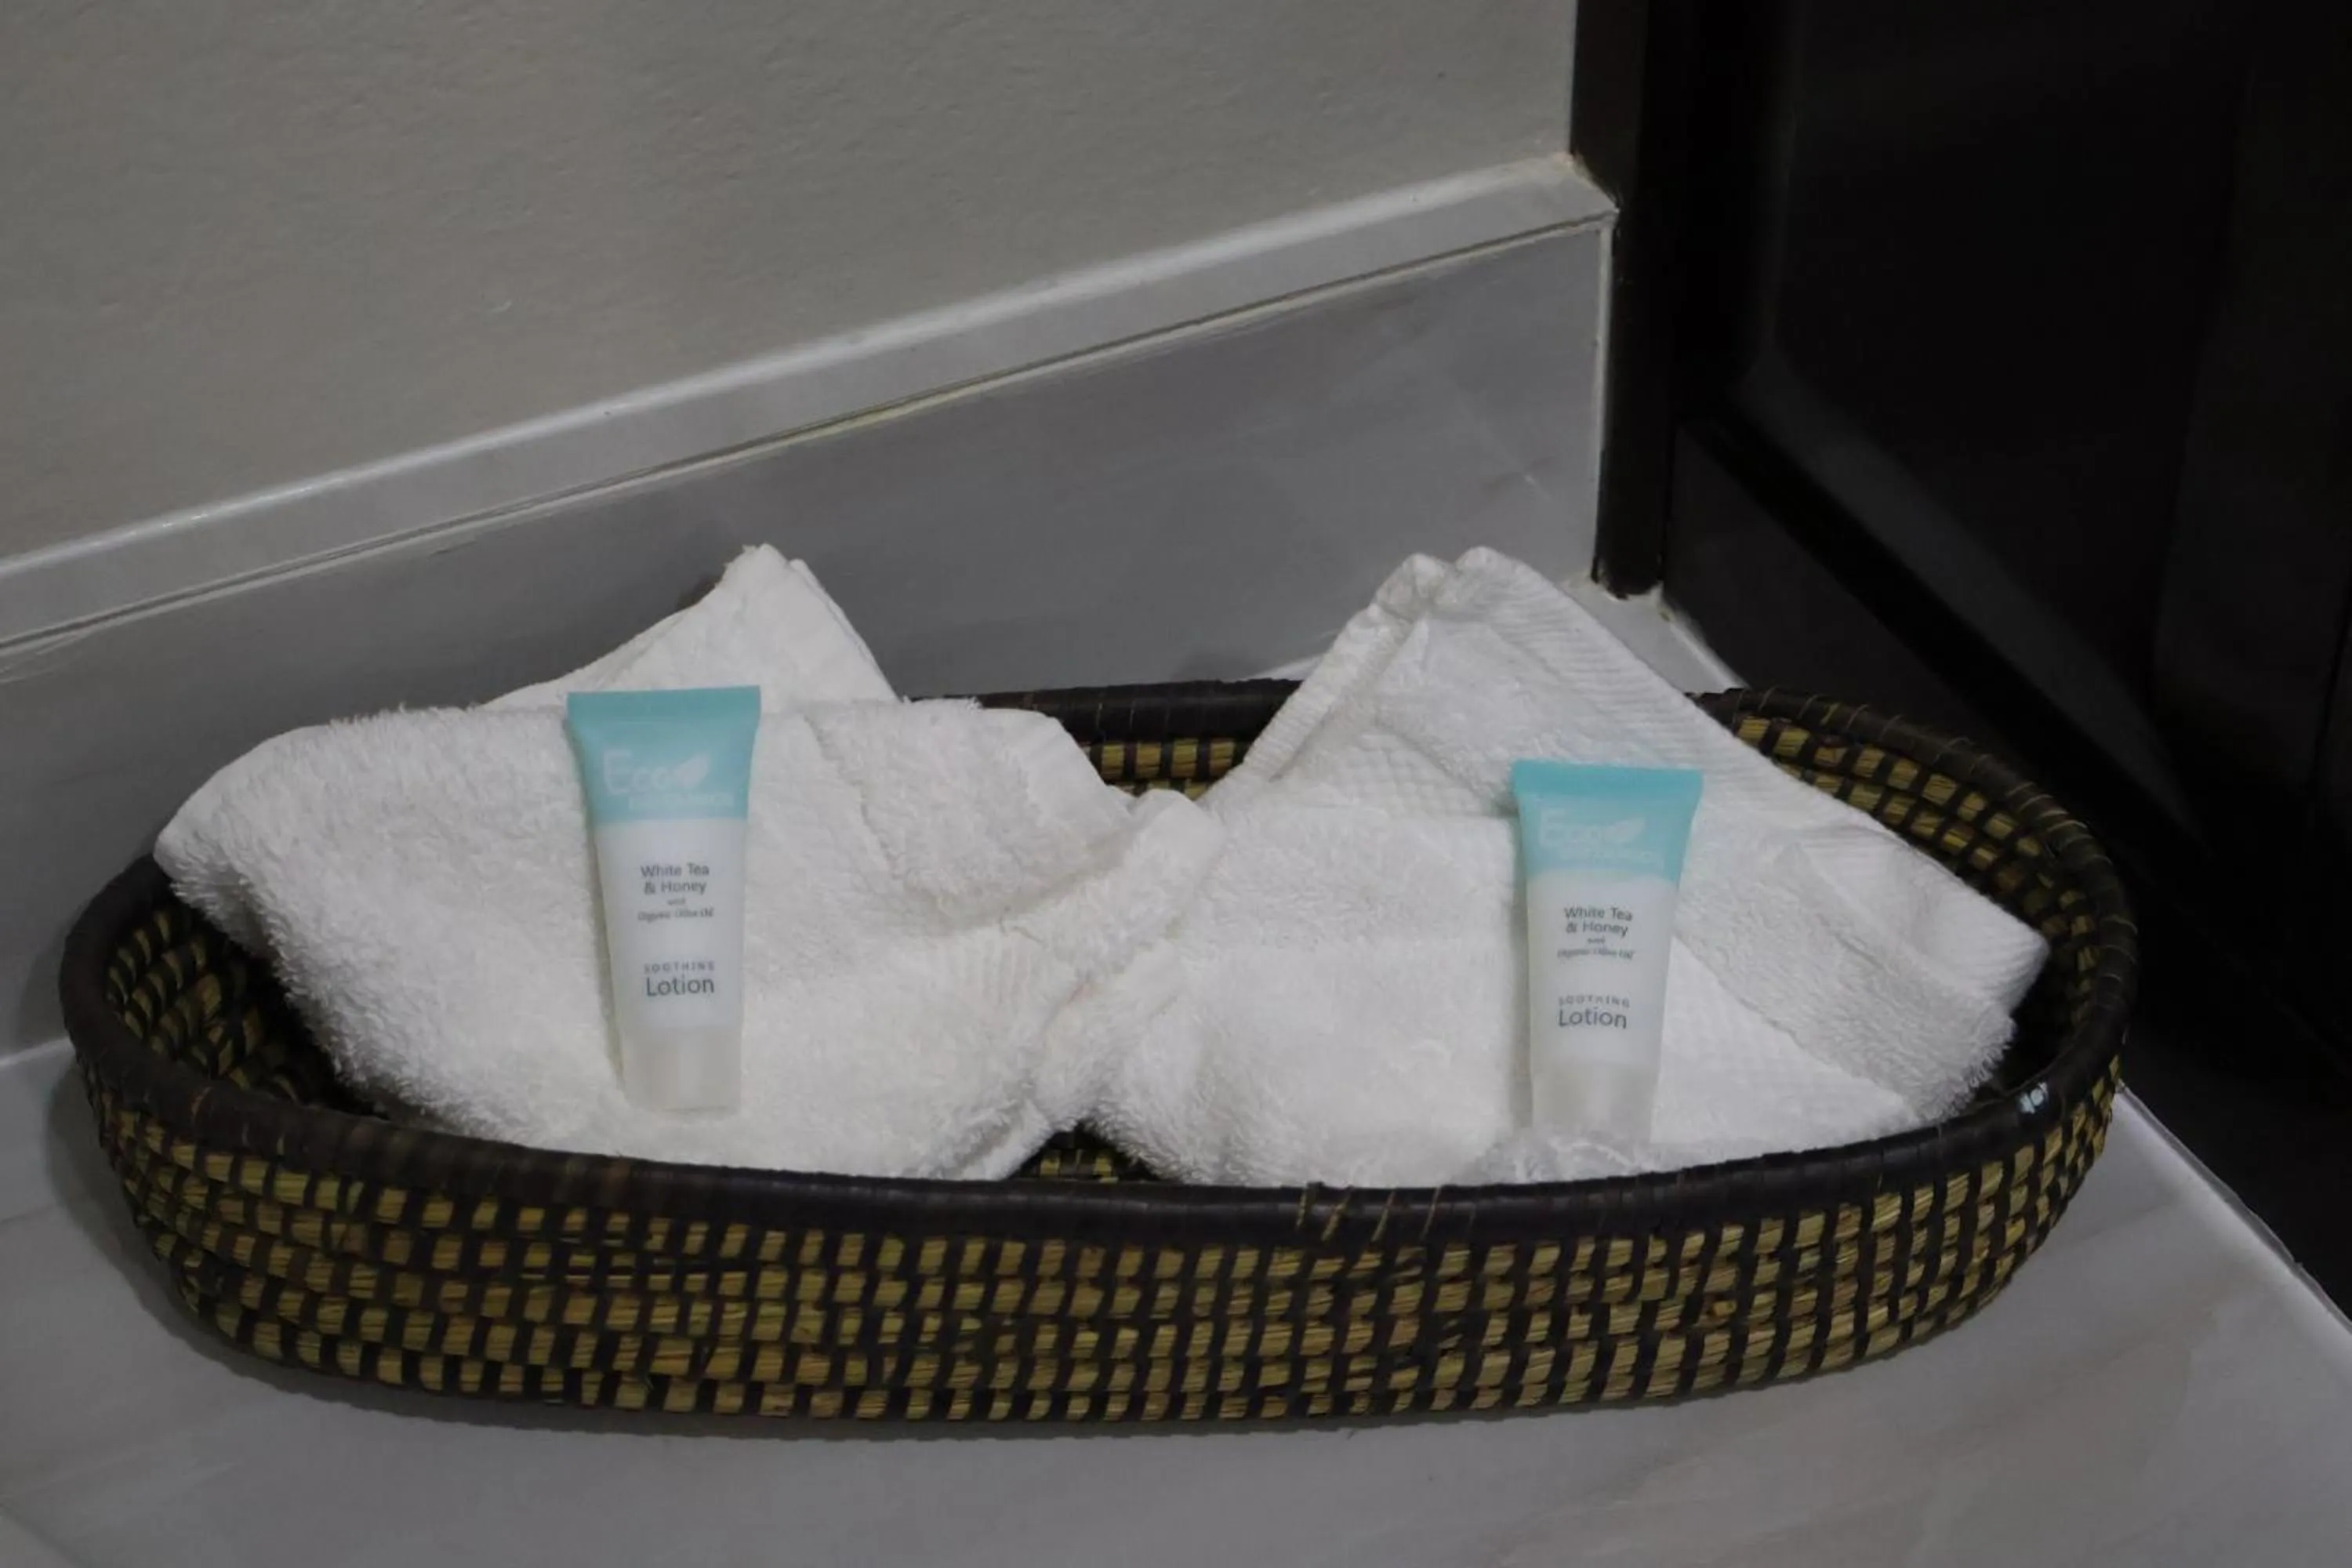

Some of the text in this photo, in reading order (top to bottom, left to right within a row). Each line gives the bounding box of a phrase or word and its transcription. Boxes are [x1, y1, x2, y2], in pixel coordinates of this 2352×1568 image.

[640, 862, 710, 877] White Tea
[644, 880, 707, 895] & Honey
[1564, 906, 1633, 922] White Tea
[1566, 922, 1629, 938] & Honey
[647, 974, 715, 997] Lotion
[1558, 1007, 1628, 1029] Lotion
